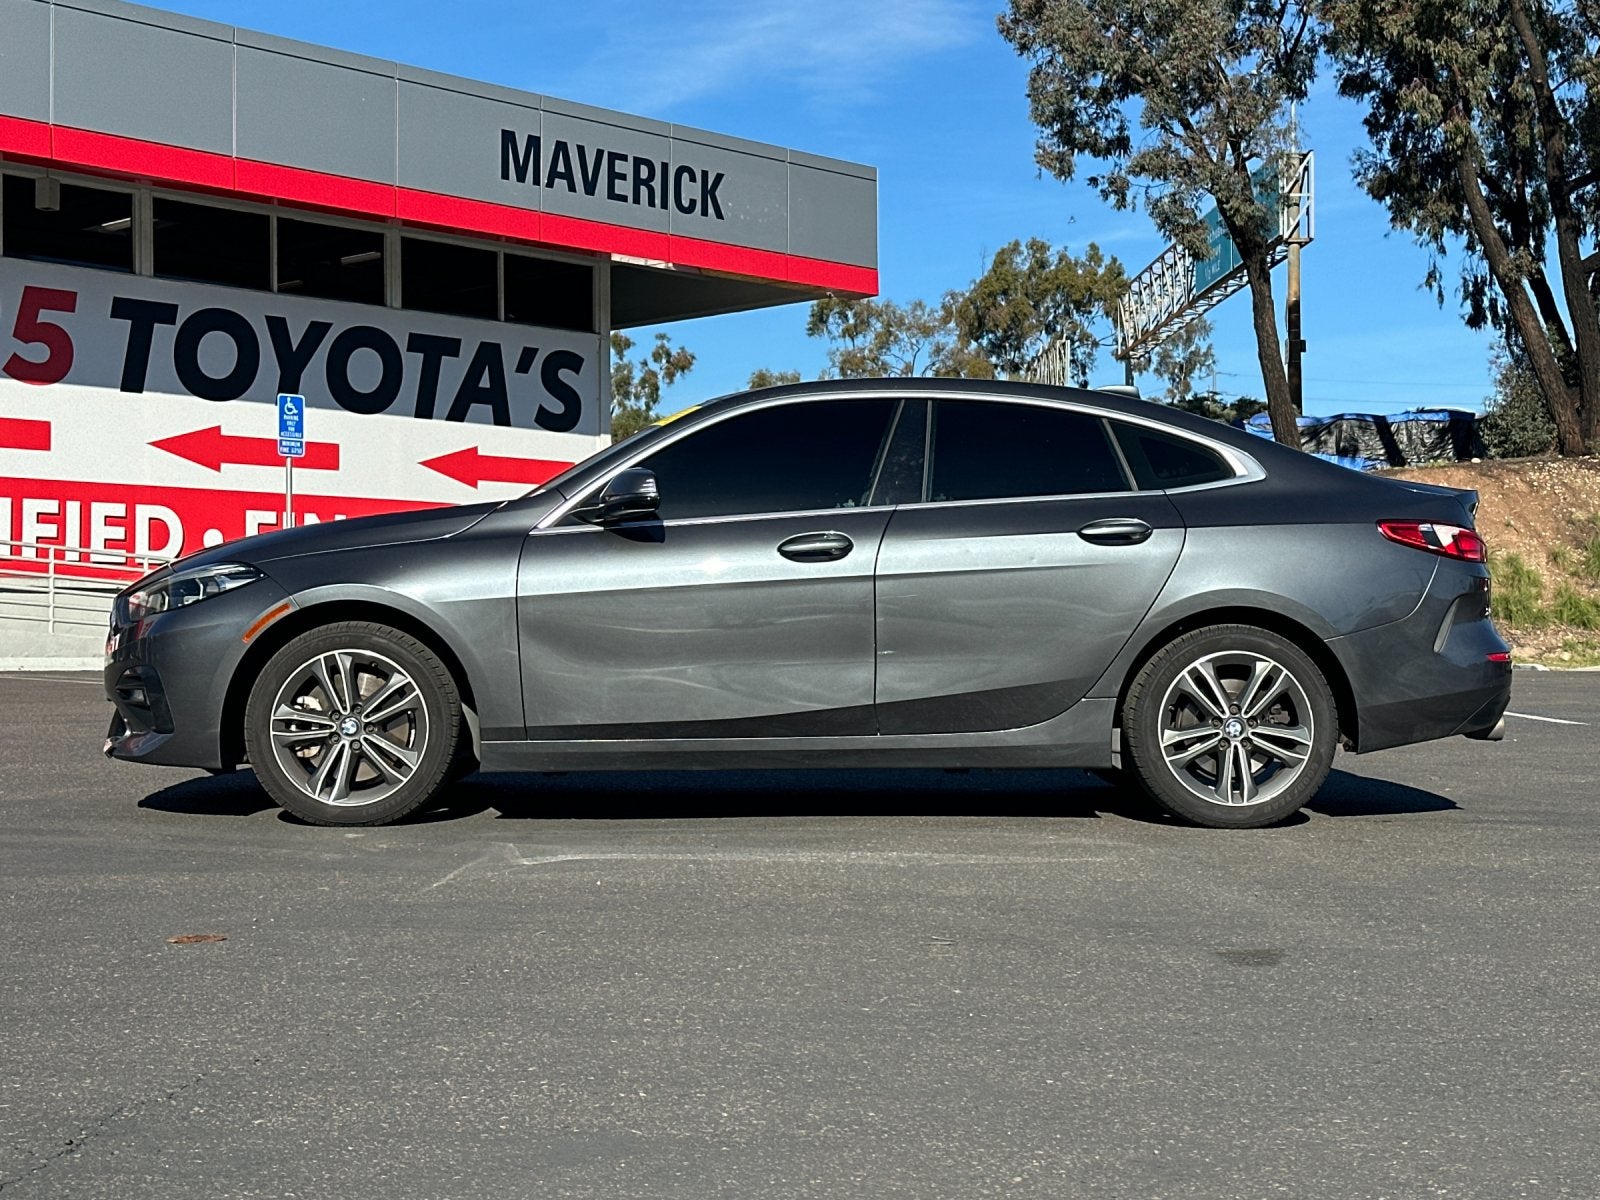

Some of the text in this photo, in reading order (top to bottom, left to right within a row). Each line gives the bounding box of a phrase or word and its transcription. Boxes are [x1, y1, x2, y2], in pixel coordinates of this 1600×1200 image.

[500, 128, 725, 221] MAVERICK
[2, 285, 585, 433] 5 TOYOTA'S
